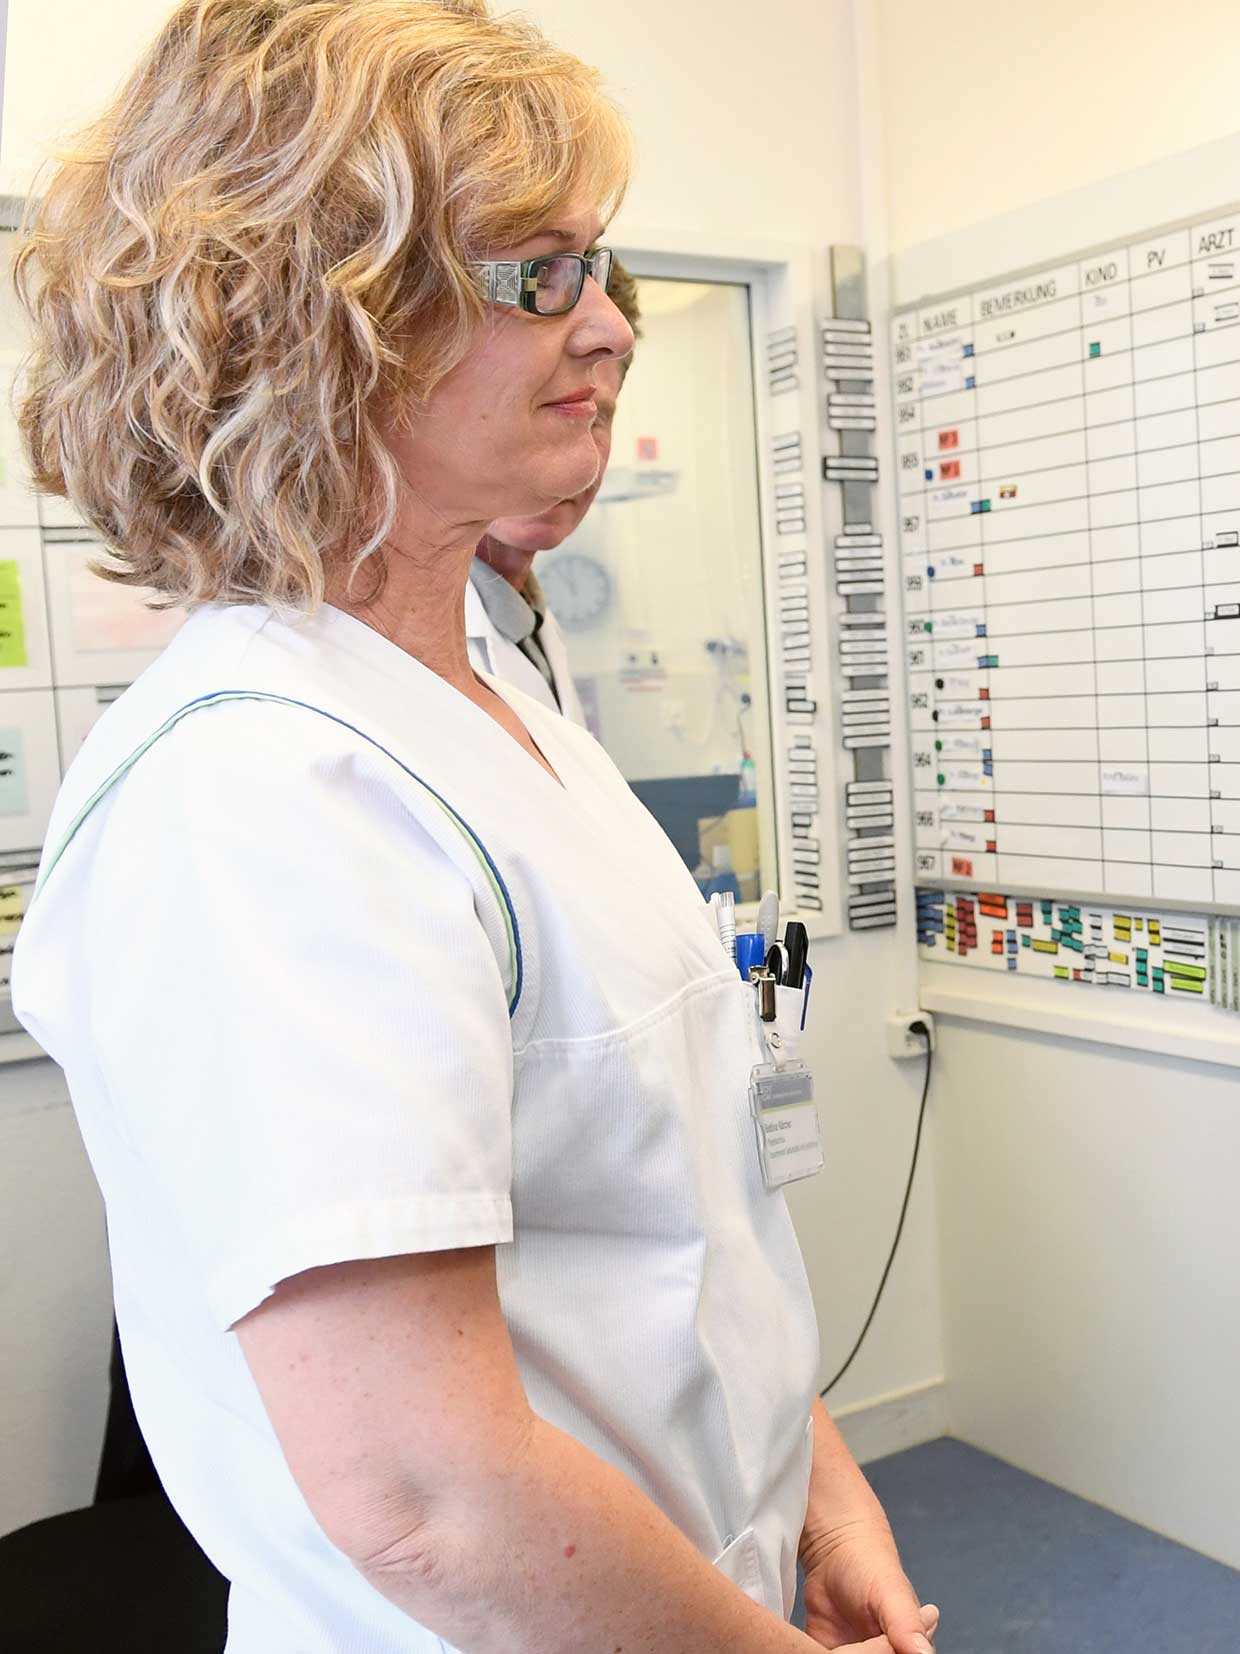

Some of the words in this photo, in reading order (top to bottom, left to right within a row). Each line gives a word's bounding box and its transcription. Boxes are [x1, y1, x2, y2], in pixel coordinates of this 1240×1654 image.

[923, 308, 957, 333] NAME
[980, 280, 1057, 318] BEMERKUNG
[1085, 263, 1118, 287] KIND
[1147, 250, 1166, 268] PV
[1199, 228, 1235, 254] ARZT
